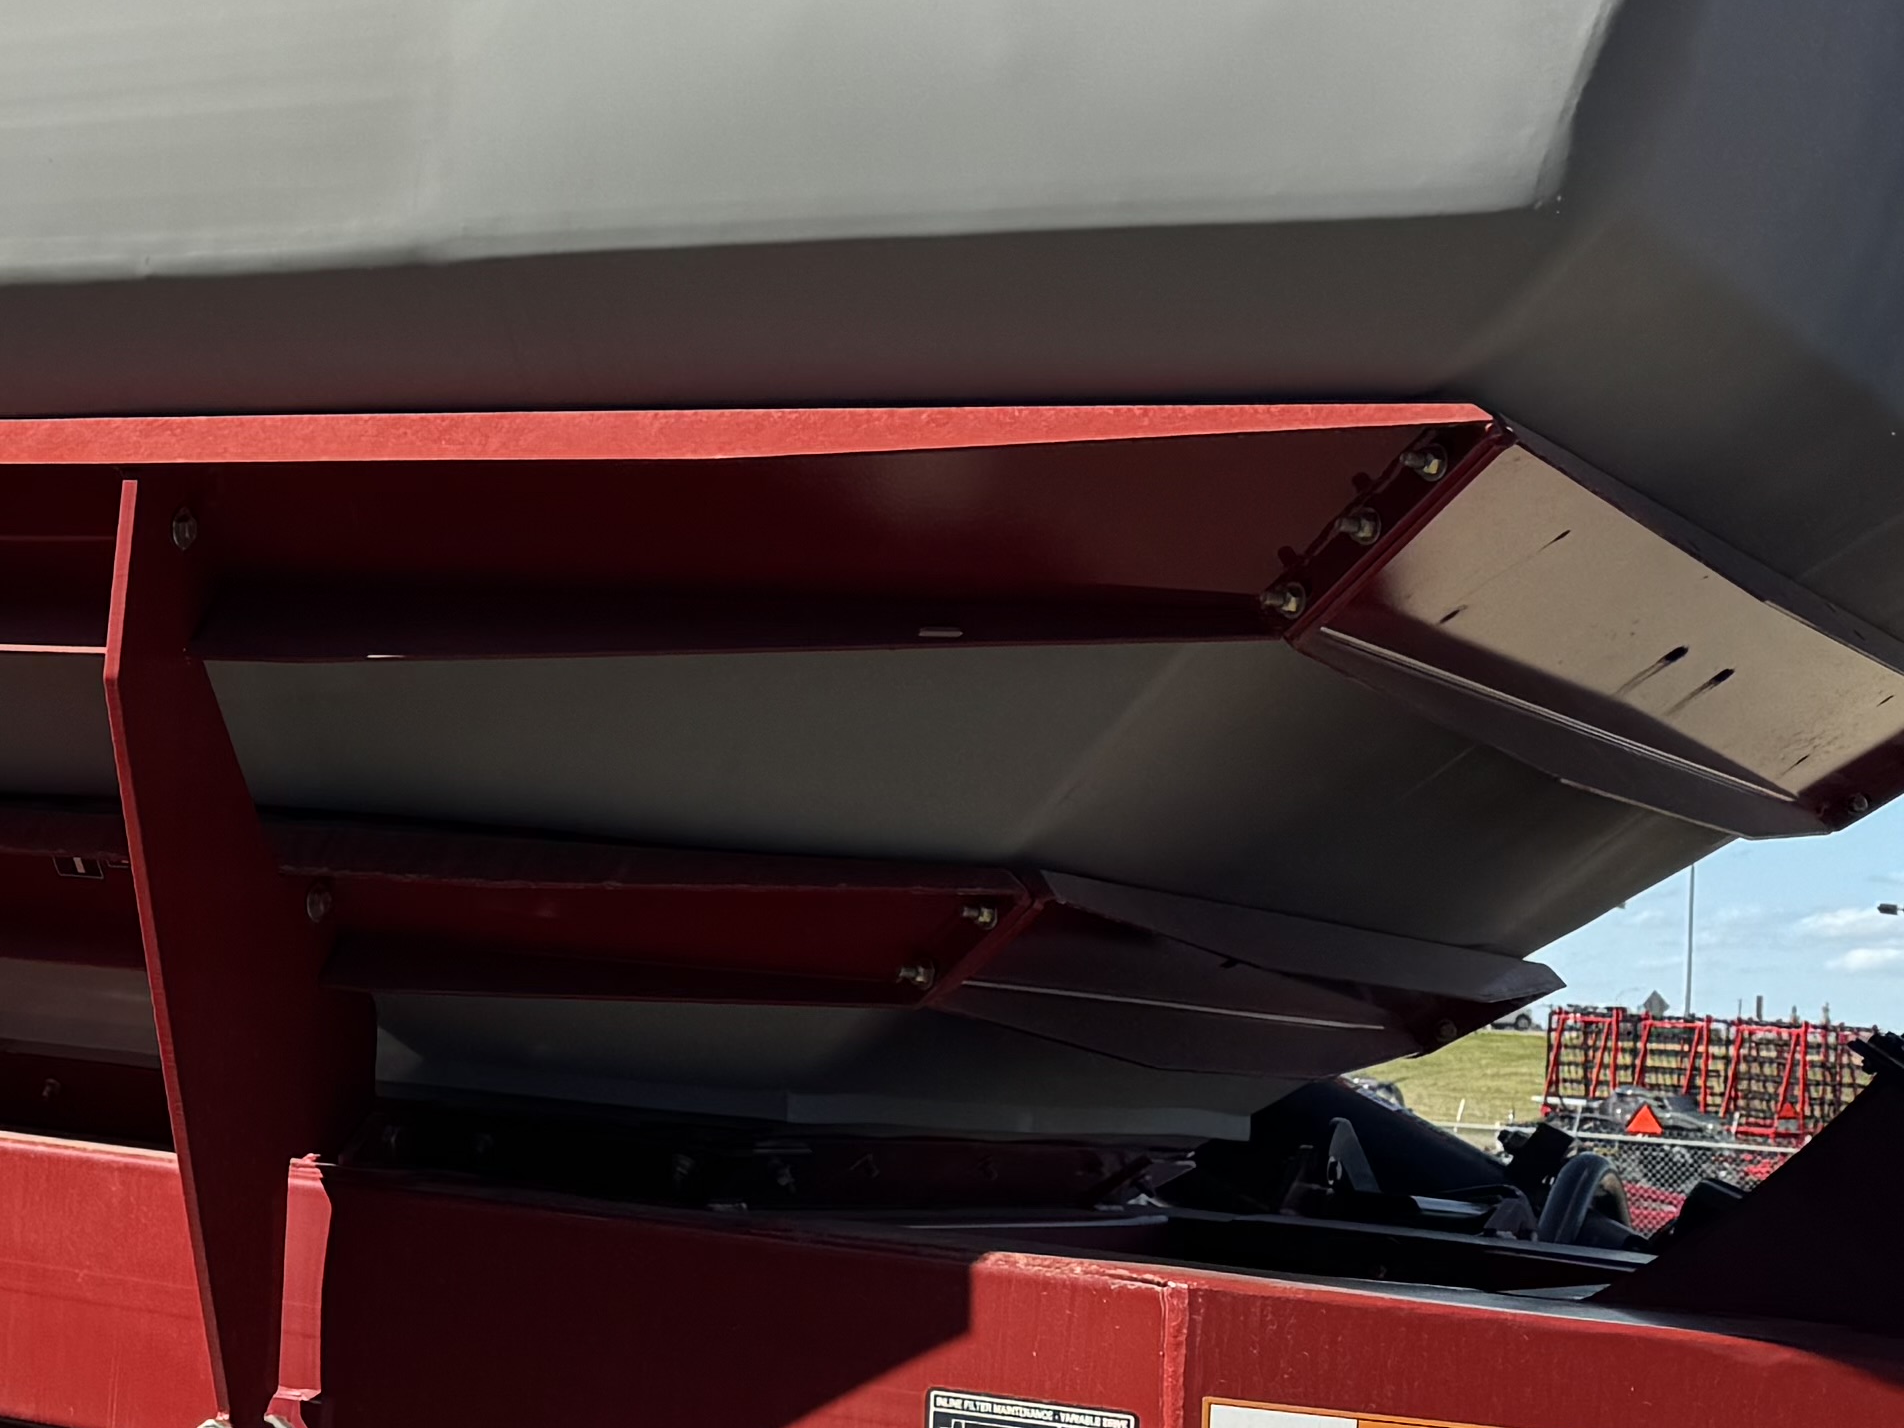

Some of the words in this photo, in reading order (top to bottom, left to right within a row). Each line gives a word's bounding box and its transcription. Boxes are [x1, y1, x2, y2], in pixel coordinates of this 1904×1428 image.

[963, 1400, 993, 1413] FILTER
[993, 1404, 1054, 1422] MAINTENANCE
[1059, 1412, 1102, 1427] VARIABLE
